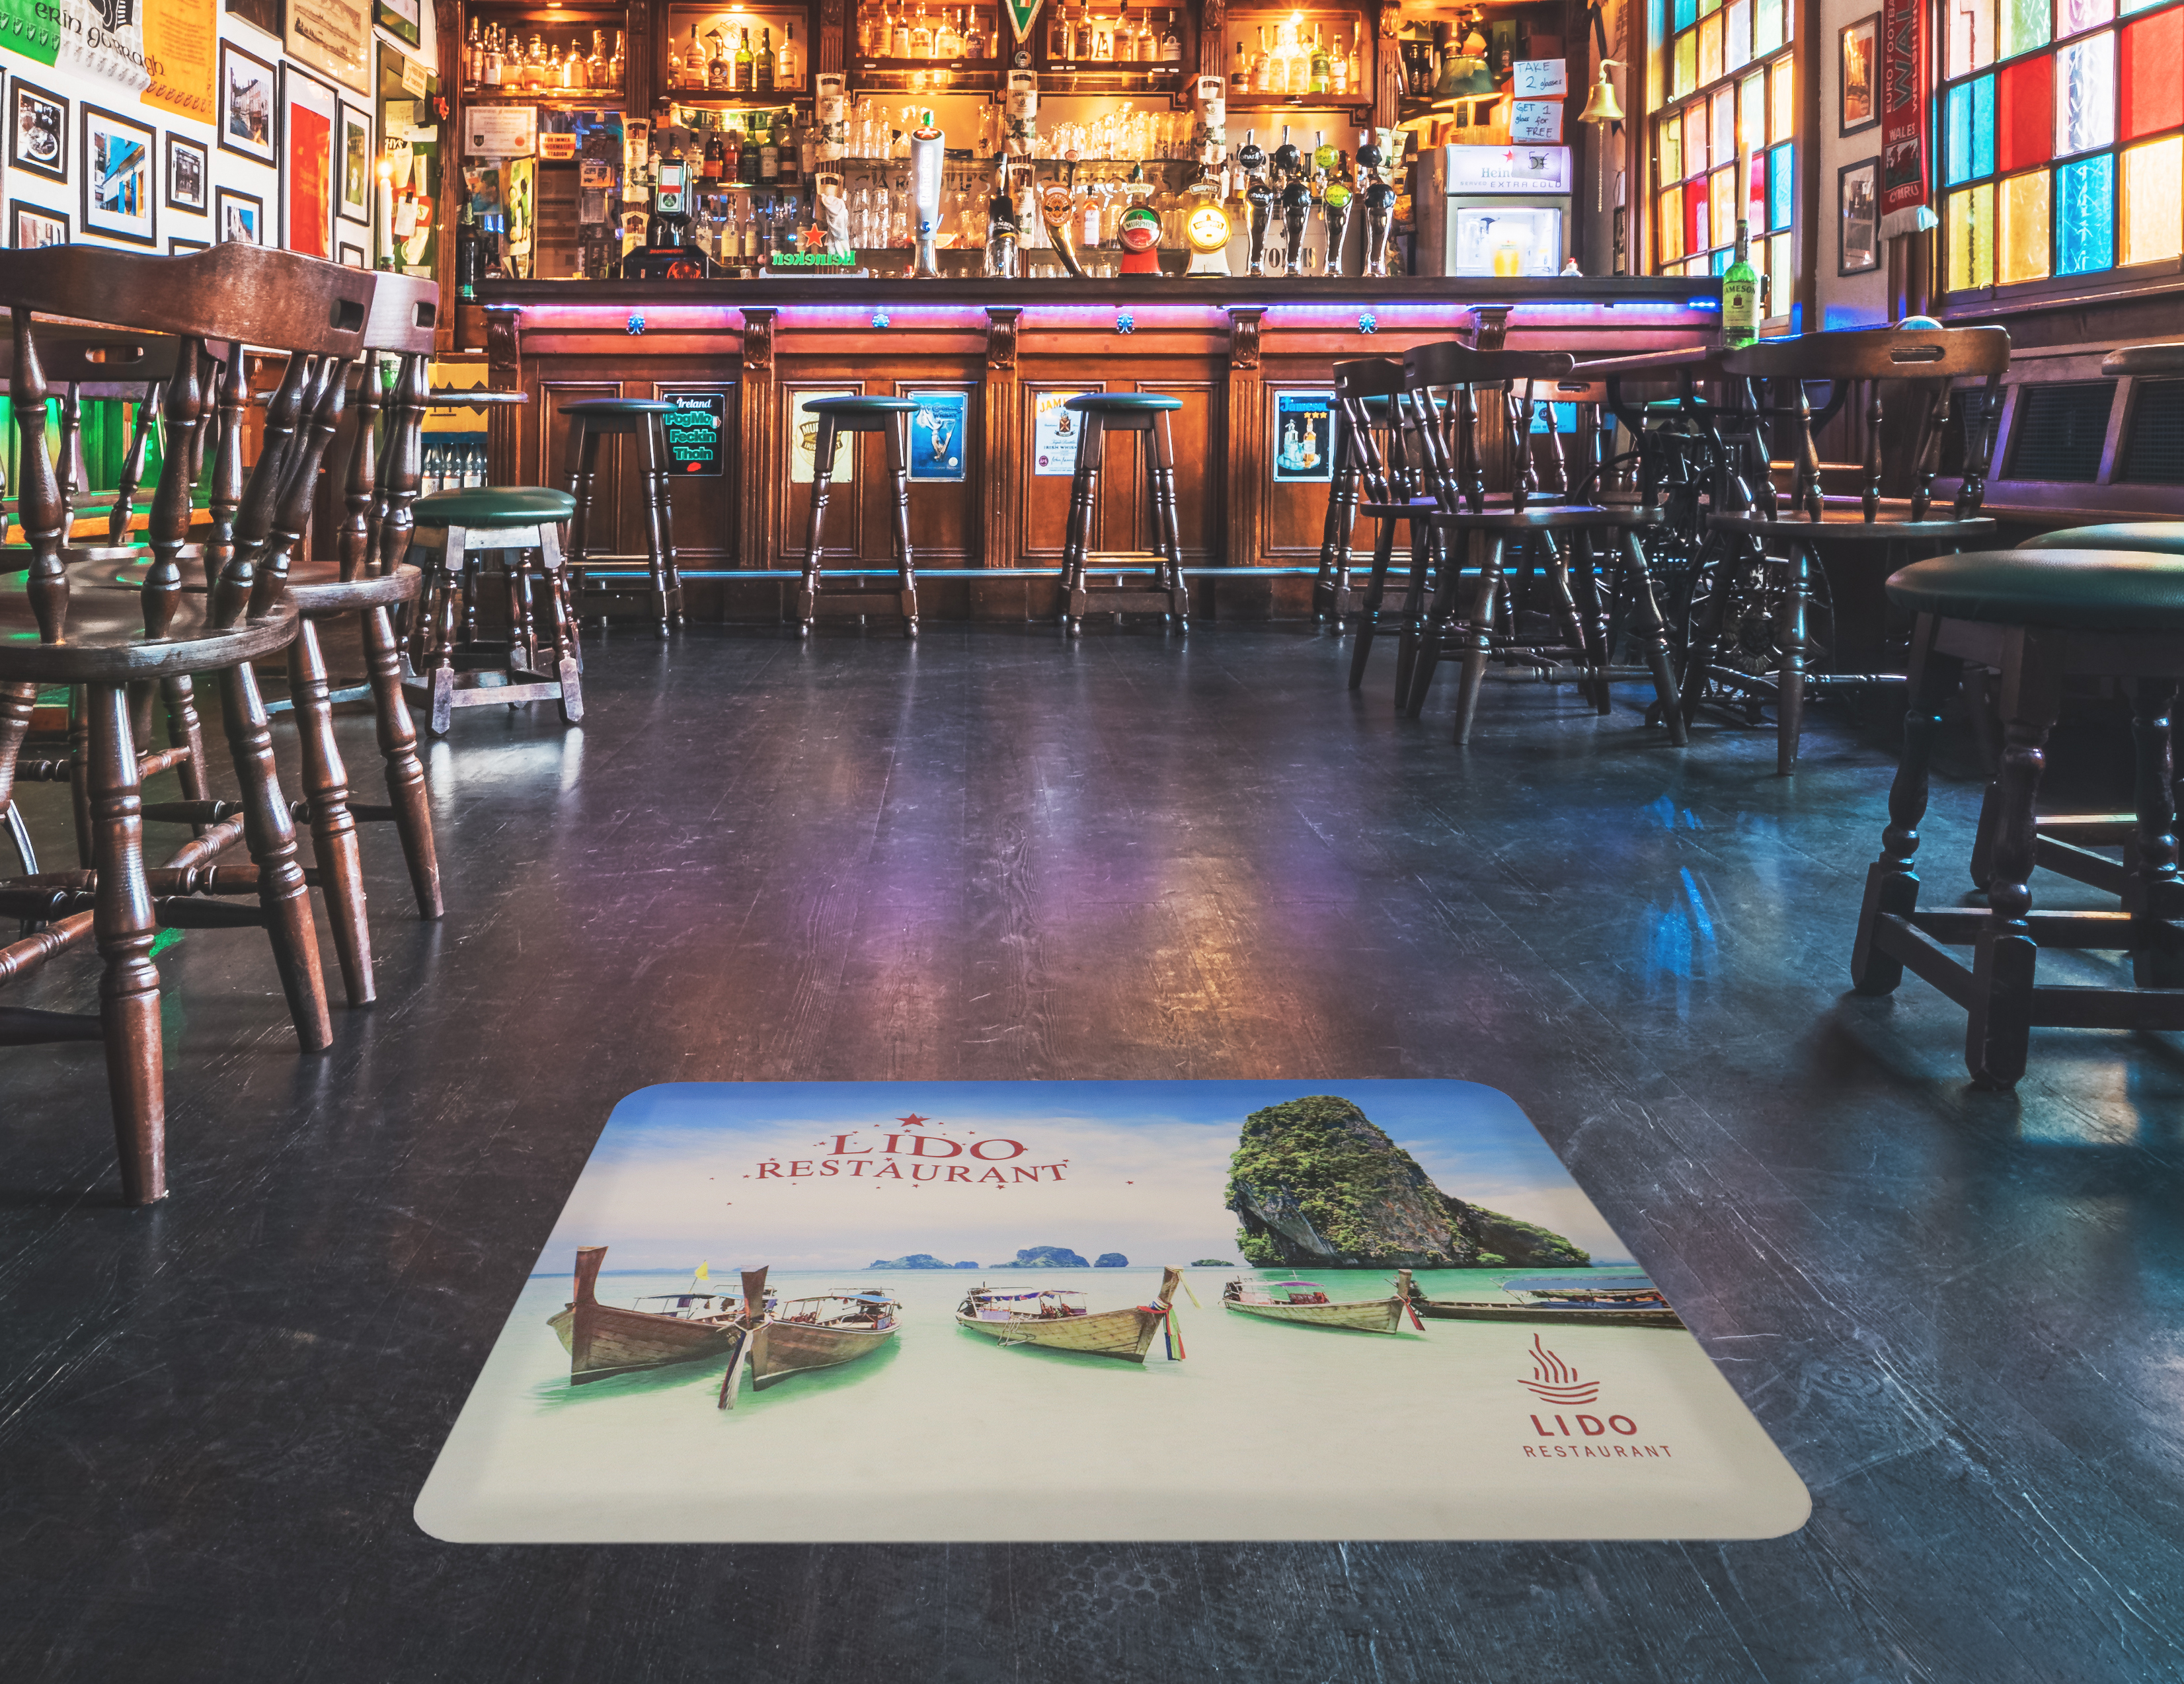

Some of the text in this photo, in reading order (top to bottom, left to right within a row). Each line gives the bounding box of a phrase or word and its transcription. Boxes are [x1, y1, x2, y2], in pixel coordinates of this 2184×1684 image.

[1517, 61, 1550, 73] TAKE
[1526, 75, 1562, 90] 2 glasses
[1516, 102, 1551, 114] GET 1
[1515, 114, 1549, 126] glass for
[1526, 126, 1553, 137] FREE
[1889, 184, 1920, 203] CYMRU
[676, 398, 711, 408] Ireland
[670, 429, 716, 443] Feckin
[673, 447, 713, 461] Thoin
[826, 1133, 1025, 1161] LIDO
[755, 1159, 1068, 1183] RESTAURANT
[1530, 1414, 1637, 1436] LIDO
[1522, 1445, 1672, 1457] RESTAURANT
